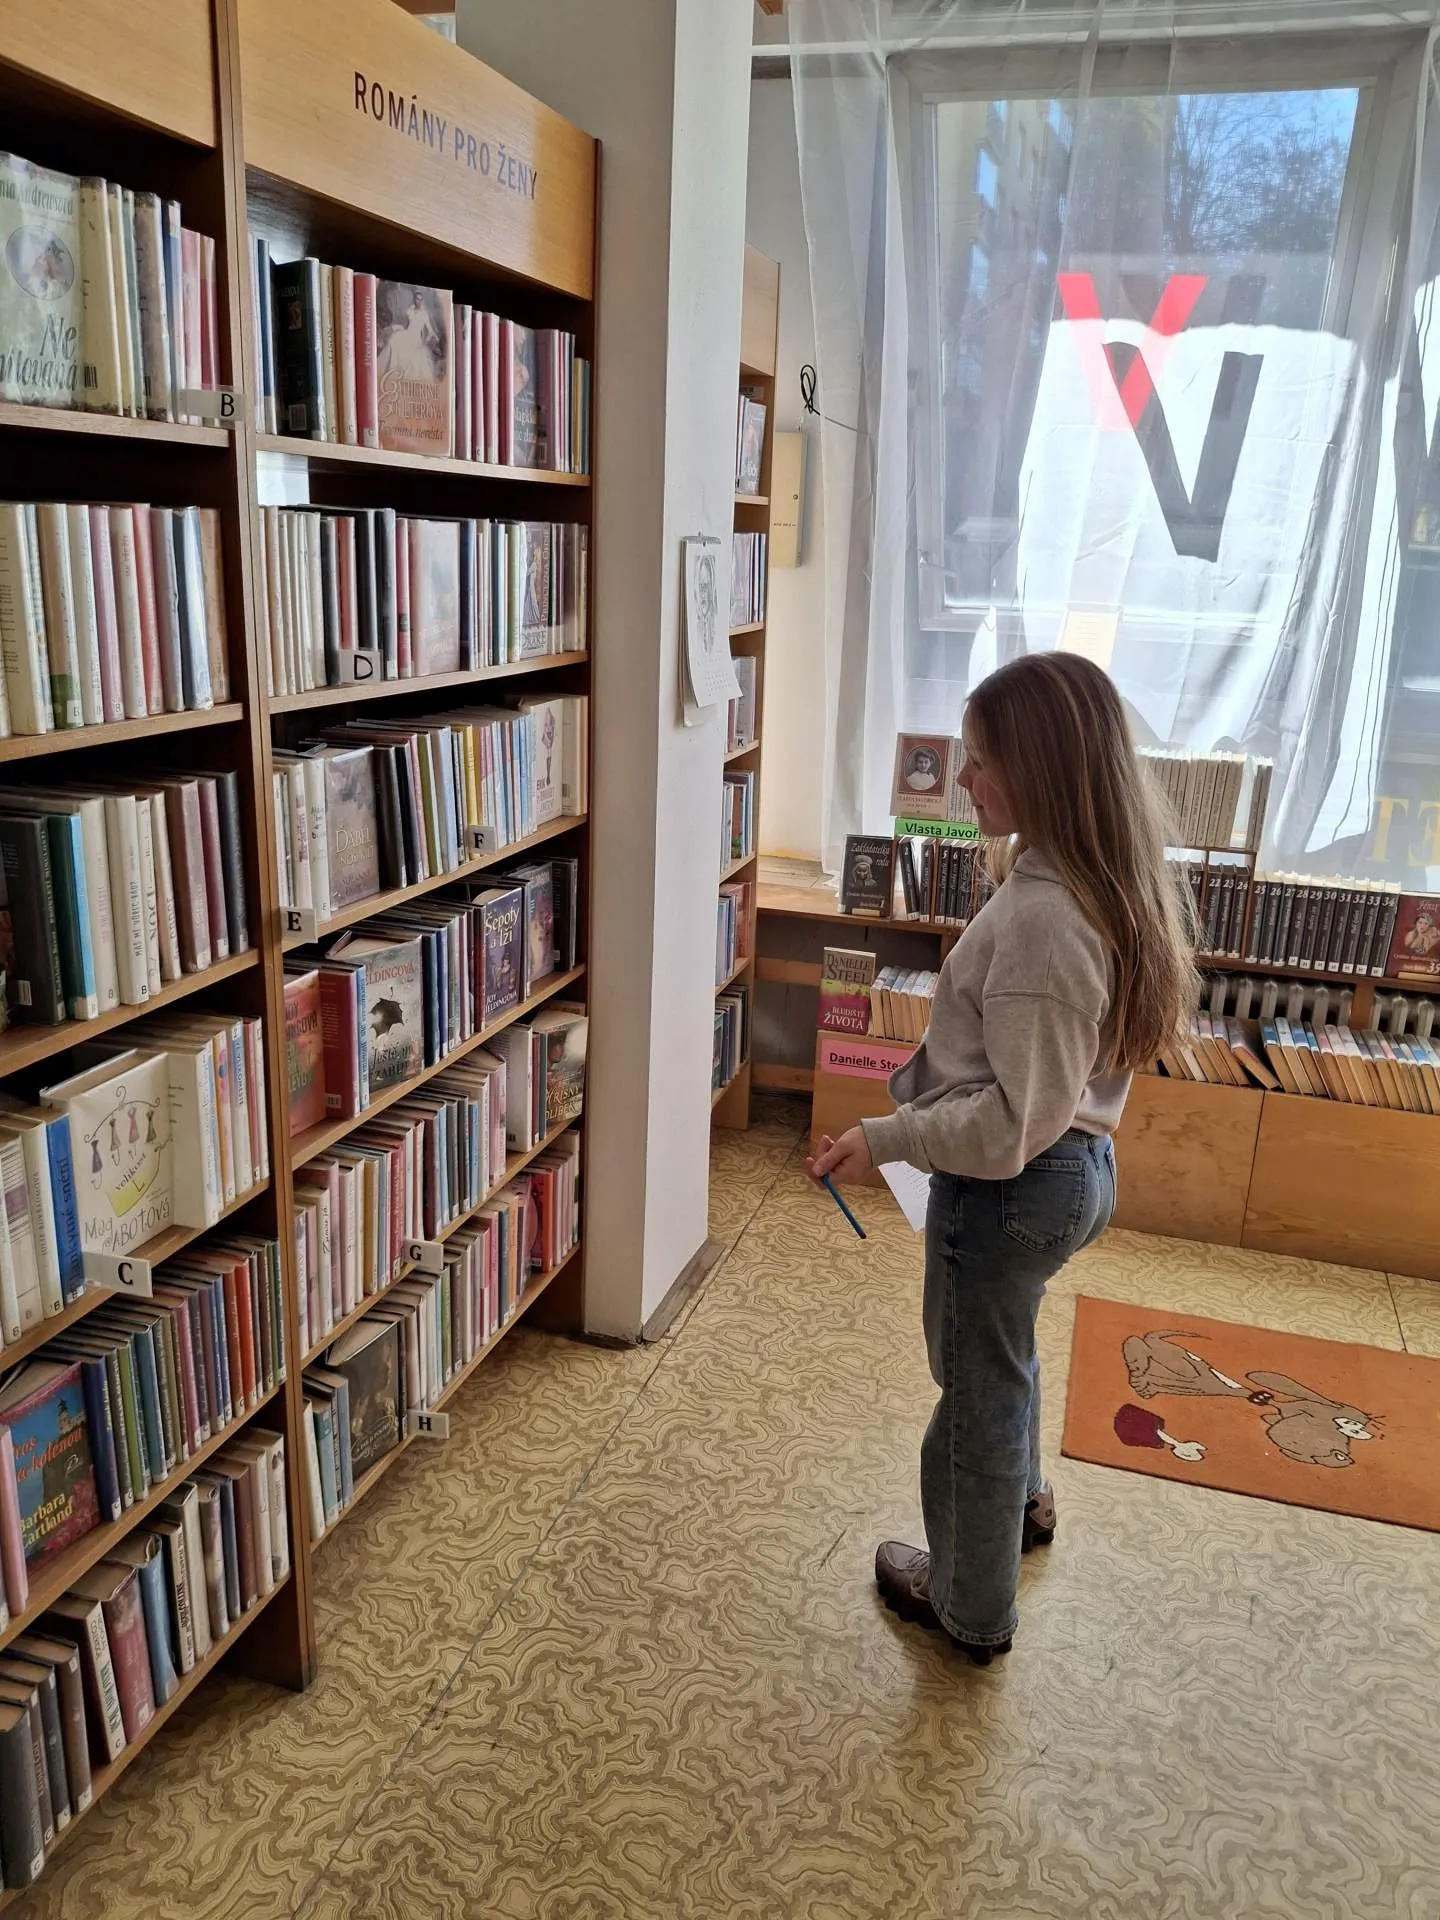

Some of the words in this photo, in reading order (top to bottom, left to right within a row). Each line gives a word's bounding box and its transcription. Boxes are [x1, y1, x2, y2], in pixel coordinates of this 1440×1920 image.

[354, 71, 447, 152] ROMÁNY
[454, 127, 490, 176] PRO
[497, 143, 537, 200] ŽENY
[220, 394, 235, 417] B
[353, 654, 374, 681] D
[905, 822, 942, 836] Vlasta
[473, 832, 485, 849] F
[1209, 878, 1221, 888] 22
[1223, 879, 1235, 889] 23
[1236, 881, 1249, 890] 24
[1254, 885, 1267, 895] 25
[1270, 887, 1282, 896] 26
[1296, 889, 1309, 898] 28
[1310, 890, 1322, 900] 29
[1324, 890, 1337, 900] 30
[1339, 892, 1352, 902] 31
[1353, 894, 1366, 904] 32
[1367, 895, 1380, 906] 33
[1382, 896, 1395, 907] 34
[287, 911, 302, 932] E
[485, 904, 520, 936] Šepoty
[826, 953, 872, 969] DANIELLE
[826, 963, 870, 984] STEEL
[823, 1011, 864, 1030] ŽIVOTA
[829, 1052, 877, 1068] Danielle
[115, 1151, 147, 1192] velikost
[409, 1244, 422, 1262] G
[117, 1262, 134, 1286] C
[418, 1414, 432, 1432] H
[19, 1491, 66, 1533] Barbara
[21, 1501, 74, 1548] Cartland
